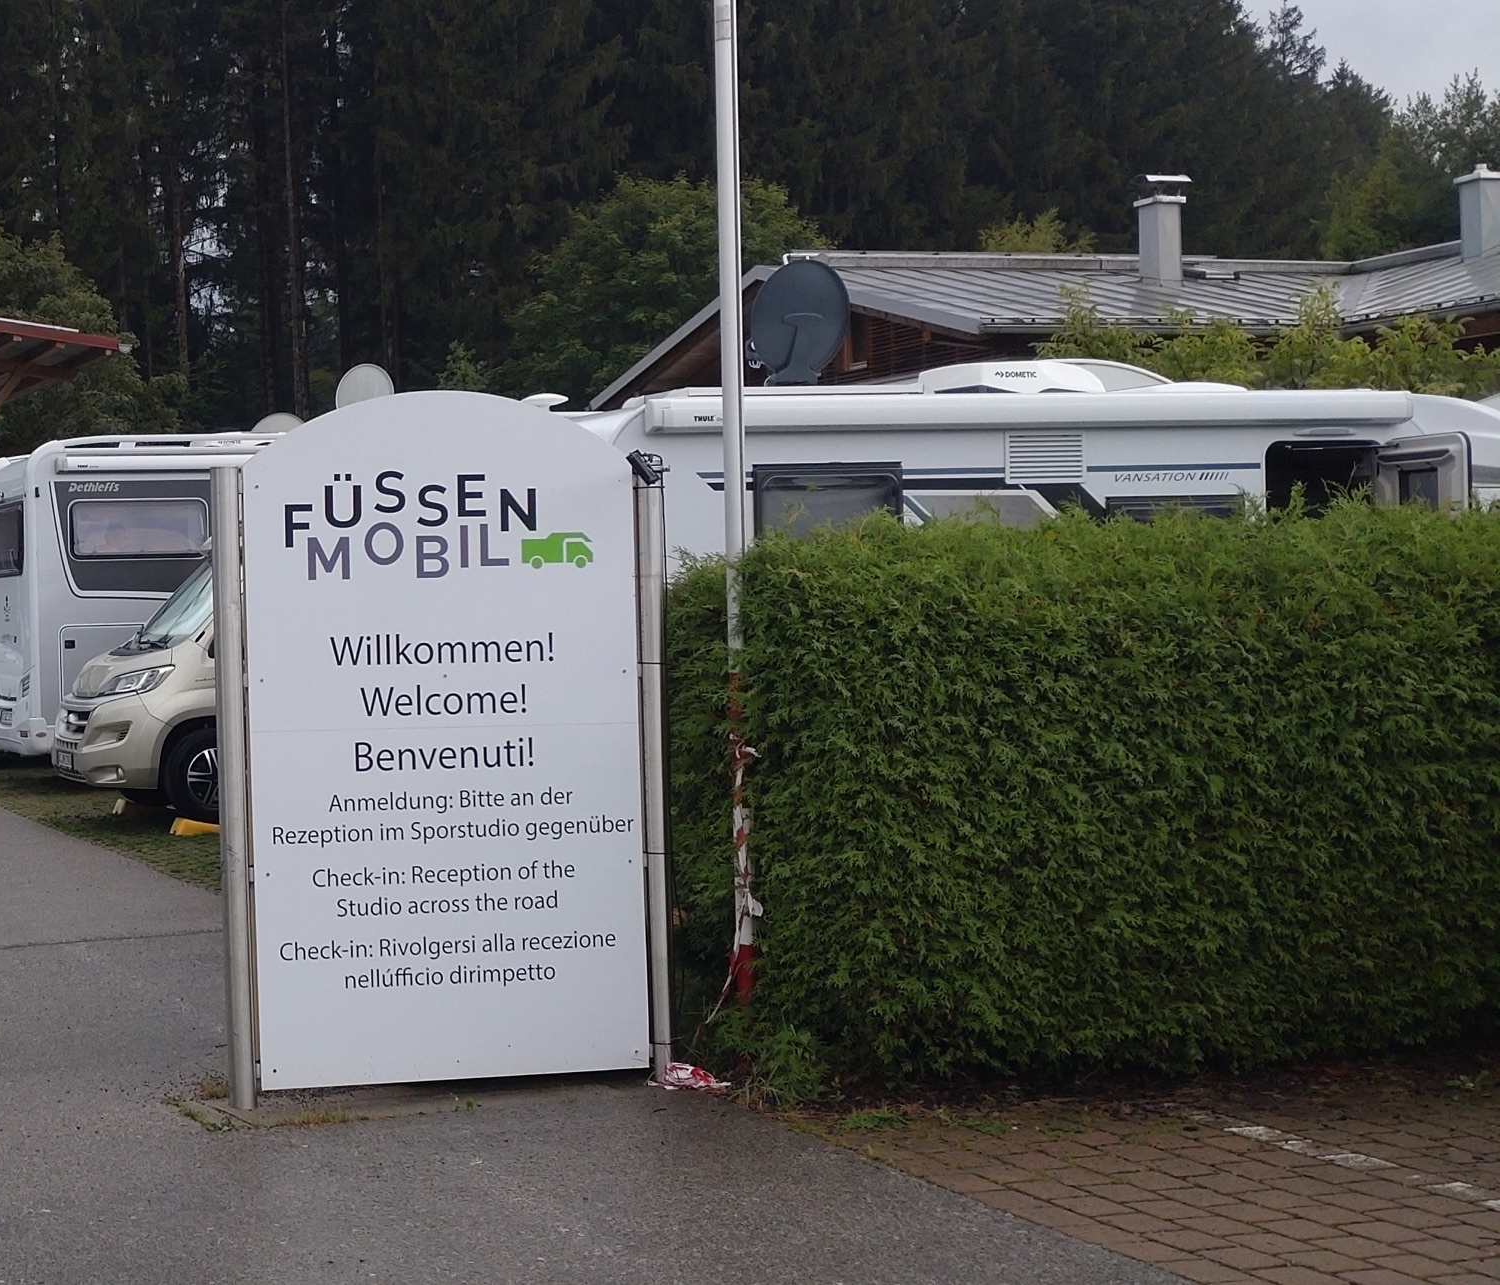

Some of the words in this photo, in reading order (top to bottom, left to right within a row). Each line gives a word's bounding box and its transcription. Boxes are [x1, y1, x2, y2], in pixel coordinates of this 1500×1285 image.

[68, 482, 120, 492] Dethleffs
[1114, 472, 1197, 483] VANSATION
[284, 470, 537, 549] FÜSSEN
[307, 521, 510, 581] MOBIL
[329, 631, 554, 667] Willkommen!
[359, 683, 527, 717] Welcome!
[354, 736, 534, 772] Benvenuti!
[328, 791, 454, 814] Anmeldung:
[459, 789, 505, 809] Bitte
[510, 792, 534, 806] an
[540, 786, 574, 806] der
[272, 825, 374, 849] Rezeption
[380, 823, 405, 842] im
[410, 818, 520, 845] Sporstudio
[525, 814, 634, 841] gegenüber
[312, 867, 406, 888] Check-in:
[411, 863, 512, 888] Reception
[517, 860, 539, 881] of
[542, 860, 576, 879] the
[336, 896, 402, 918] Studio
[407, 899, 470, 915] across
[474, 893, 508, 912] the
[514, 890, 558, 911] road
[279, 938, 374, 962] Check-in:
[379, 935, 476, 961] Rivolgersi
[481, 933, 516, 953] alla
[521, 931, 616, 951] recezione
[449, 963, 556, 987] dirimpetto
